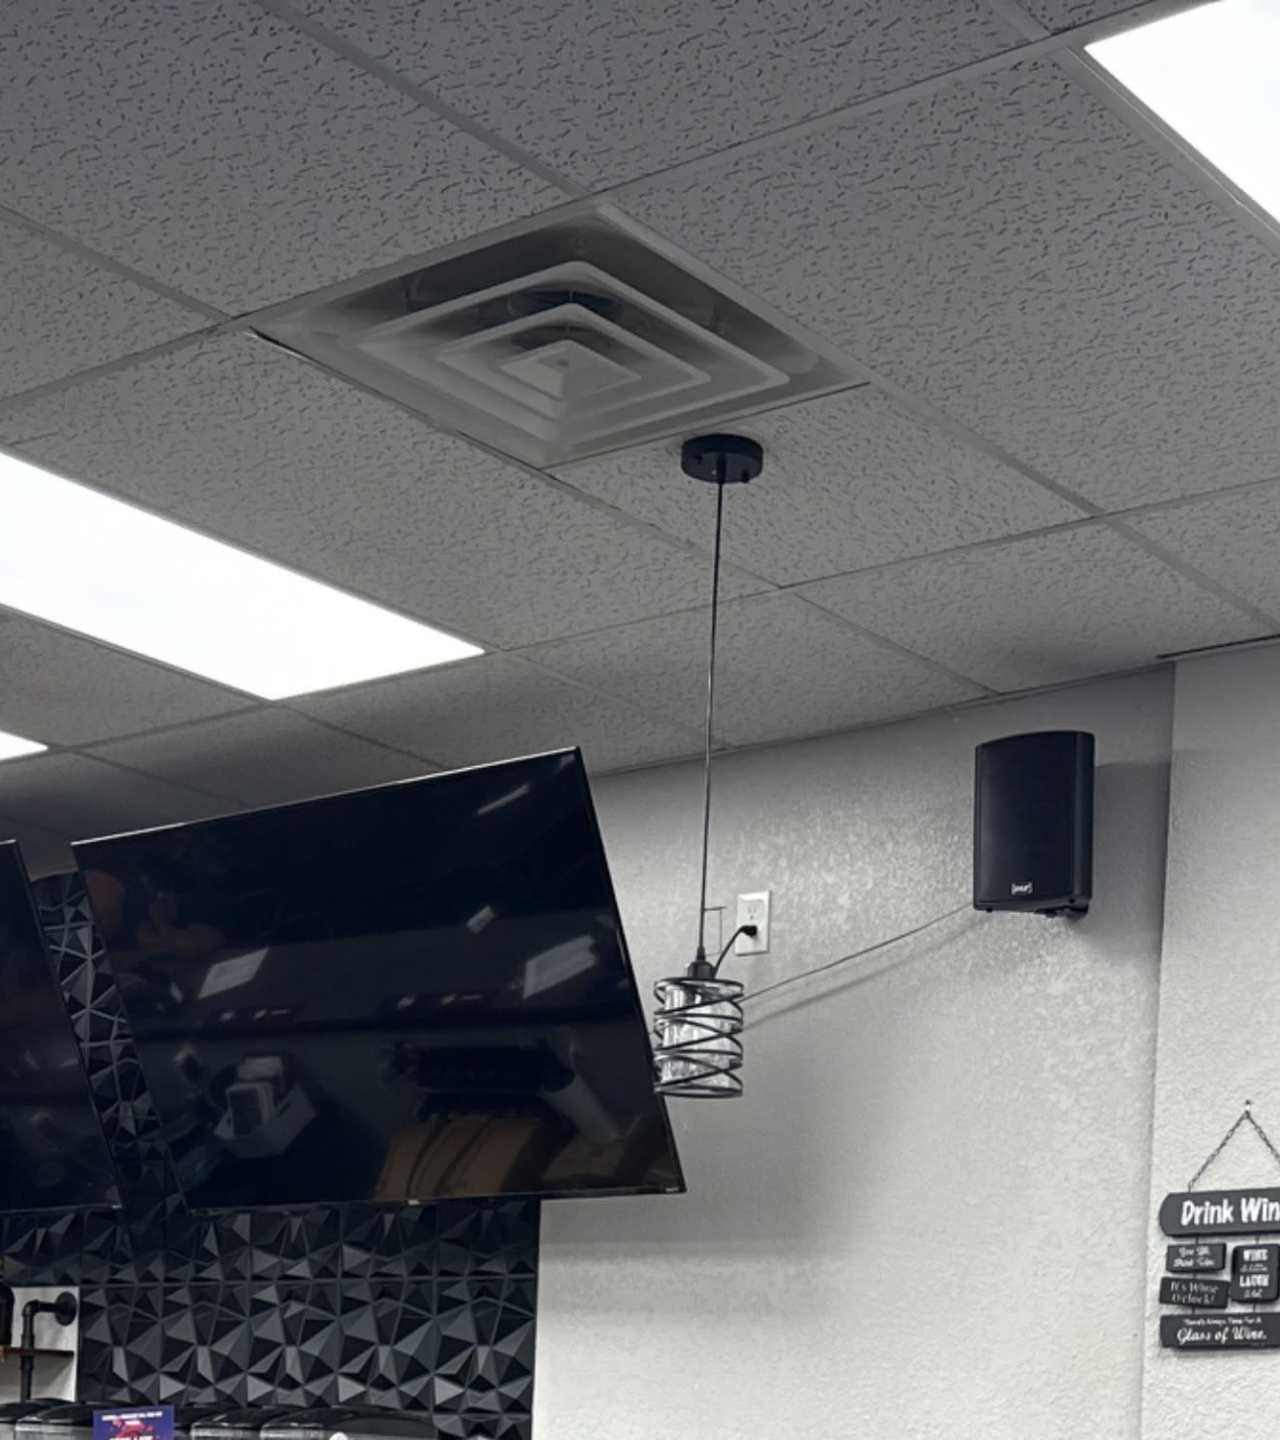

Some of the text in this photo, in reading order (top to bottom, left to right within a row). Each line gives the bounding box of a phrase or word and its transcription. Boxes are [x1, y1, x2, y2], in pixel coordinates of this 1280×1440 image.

[1181, 1198, 1235, 1226] Drink
[1177, 1327, 1211, 1345] Glass
[1214, 1326, 1230, 1344] of
